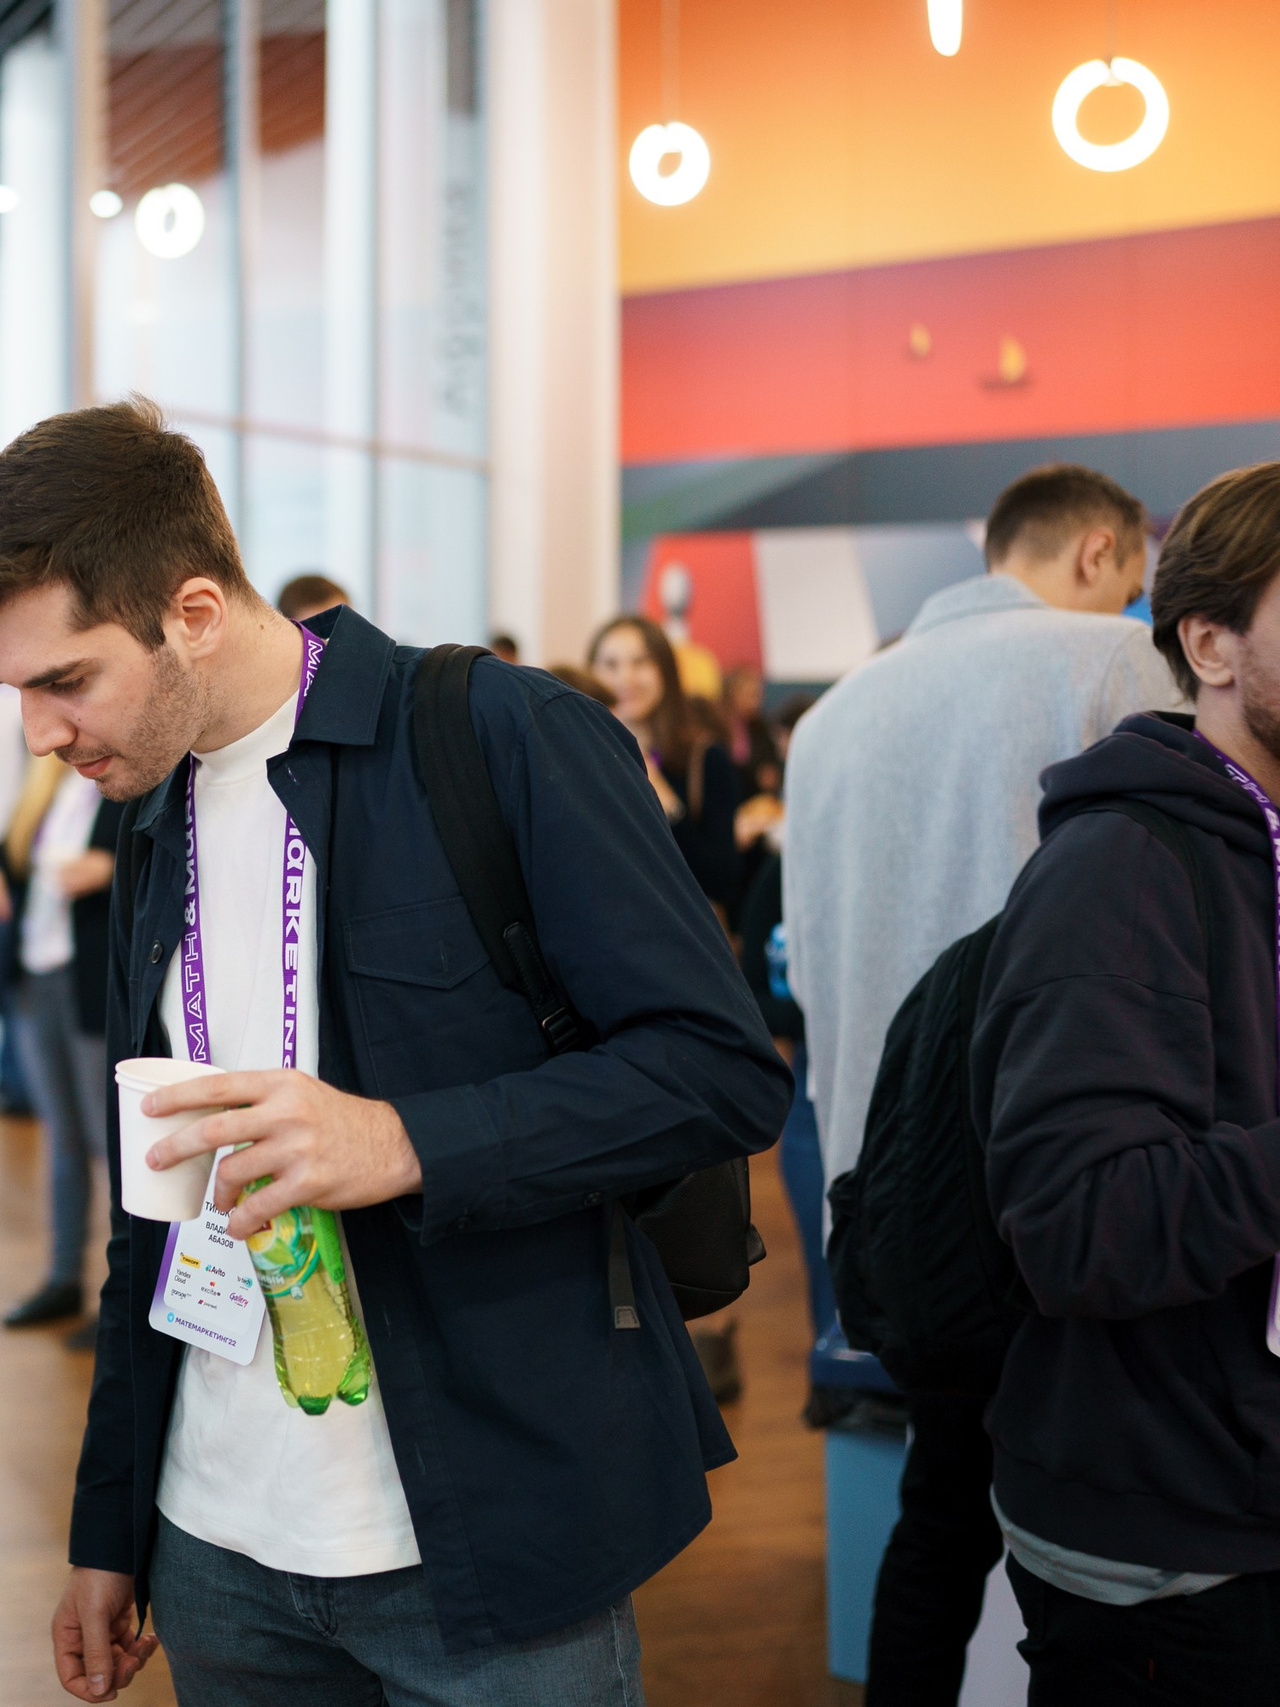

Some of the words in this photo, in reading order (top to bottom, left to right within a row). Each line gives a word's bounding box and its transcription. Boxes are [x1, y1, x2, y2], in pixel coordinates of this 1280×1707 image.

[184, 898, 197, 926] &
[185, 932, 205, 1063] MATH
[208, 1234, 234, 1249] АБАЗОВ
[211, 1266, 226, 1278] Avito
